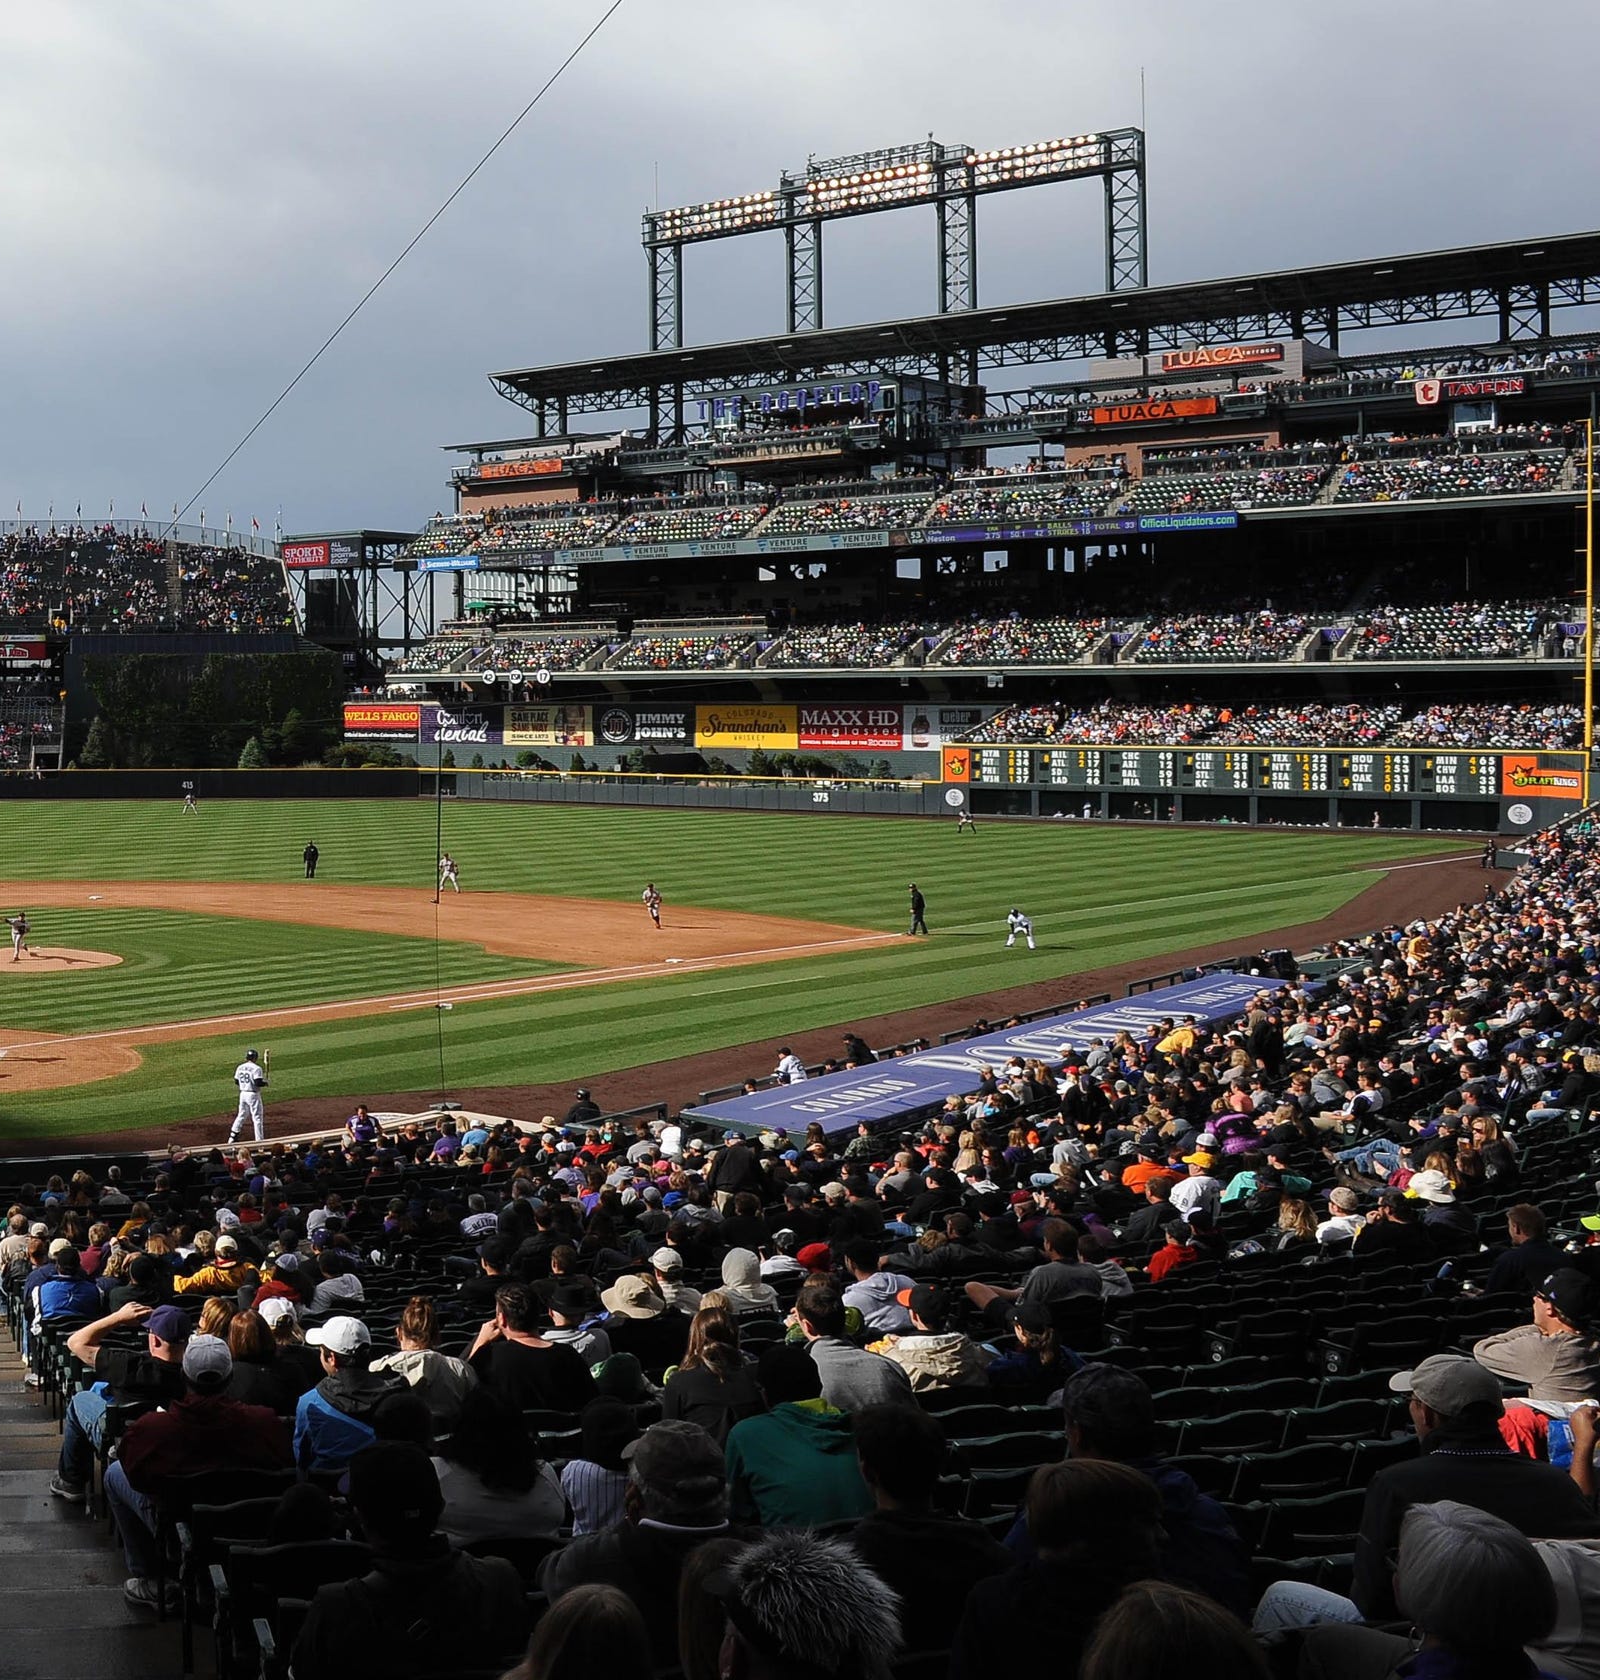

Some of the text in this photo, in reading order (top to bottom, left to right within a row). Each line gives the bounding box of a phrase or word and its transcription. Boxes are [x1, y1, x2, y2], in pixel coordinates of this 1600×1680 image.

[1163, 346, 1244, 367] TUACA
[1443, 379, 1524, 397] TAVERN
[697, 380, 880, 419] THE ROOFTOP
[1105, 403, 1177, 421] TUACA
[1140, 515, 1235, 529] OfficeLiquidators.com
[1093, 523, 1120, 531] TOTAL
[769, 538, 808, 547] VENTURE
[842, 534, 883, 543] VENTURE
[927, 535, 956, 543] Heston
[285, 545, 324, 558] SPORTS
[634, 546, 669, 555] VENTURE
[701, 543, 736, 551] VENTURE
[570, 550, 603, 558] VENTURE
[344, 711, 419, 721] WELLS FARGO
[436, 707, 483, 725] Comfort
[511, 712, 531, 722] SAME
[635, 713, 686, 727] JIMMY
[801, 710, 899, 726] MAXX HD
[531, 722, 549, 733] WAY
[701, 713, 787, 738] Stranahan's
[434, 721, 489, 742] dental
[634, 727, 687, 740] JOHN'S
[800, 726, 898, 737] sunglasses
[1015, 750, 1029, 758] 33
[1051, 751, 1100, 759] MIL 13
[1121, 752, 1173, 760] CHC 49
[1195, 753, 1248, 761] CIN 52
[1272, 754, 1327, 763] TEX 22
[982, 758, 1029, 766] PIT 34
[1051, 759, 1100, 768] ATL 17
[1351, 755, 1409, 764] HOU 43
[1435, 756, 1496, 765] MIN 65
[1159, 761, 1173, 769] 12
[1233, 762, 1248, 770] 28
[1311, 764, 1327, 772] 52
[1351, 764, 1410, 773] DET 53
[1015, 767, 1029, 775] 35
[1051, 768, 1100, 777] SD 22
[1121, 770, 1173, 778] BAL 59
[1436, 765, 1495, 775] CHW 49
[1015, 775, 1030, 784] 37
[1195, 771, 1248, 779] STL 41
[1272, 772, 1327, 781] SEA 65
[1352, 774, 1409, 783] OAK 31
[1051, 776, 1100, 785] LAD 46
[1122, 778, 1173, 787] MIA 15
[1195, 779, 1248, 788] KC 36
[1435, 775, 1496, 785] LAA 33
[1272, 781, 1327, 791] TOR 56
[1352, 783, 1409, 792] TB 51
[1435, 785, 1496, 795] BOS 35
[812, 792, 829, 803] 375
[239, 1072, 251, 1084] 28
[790, 1079, 917, 1113] COLORADO
